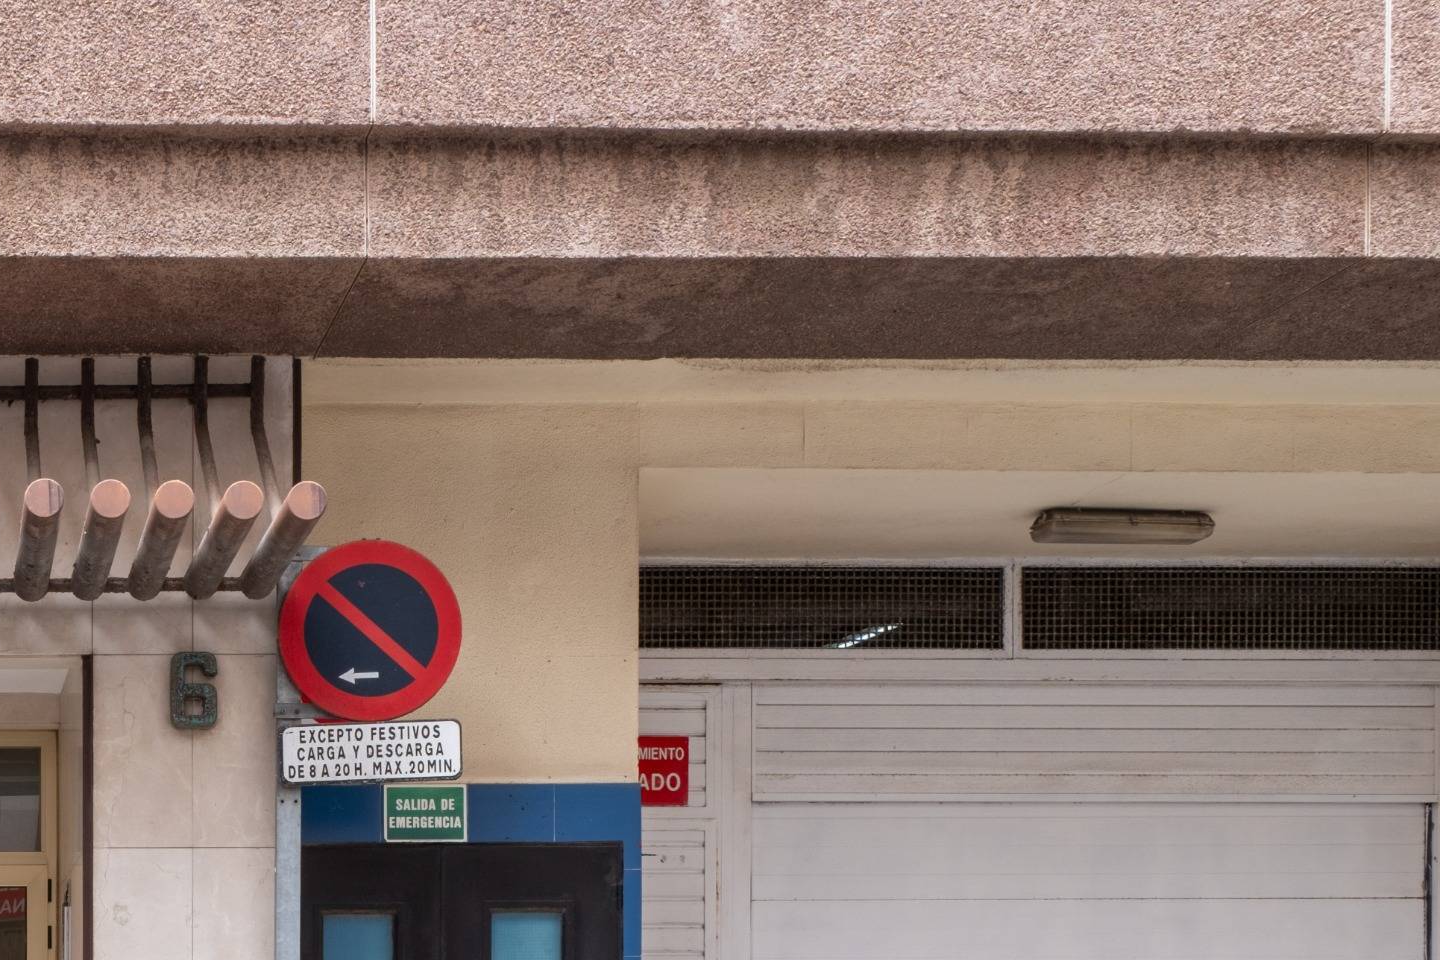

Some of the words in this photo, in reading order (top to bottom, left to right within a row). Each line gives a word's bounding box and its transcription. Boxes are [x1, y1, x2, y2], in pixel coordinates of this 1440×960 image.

[170, 651, 218, 730] 6
[299, 728, 364, 744] EXCEPTO
[370, 724, 441, 741] FESTIVOS
[297, 746, 346, 761] CARGA
[353, 745, 360, 759] Y
[366, 742, 444, 758] DESCARGA
[288, 765, 305, 779] DE
[310, 765, 316, 778] 8
[321, 764, 329, 778] A
[396, 798, 435, 811] SALIDA
[441, 798, 455, 811] DE
[389, 816, 462, 829] EMERGENCIA
